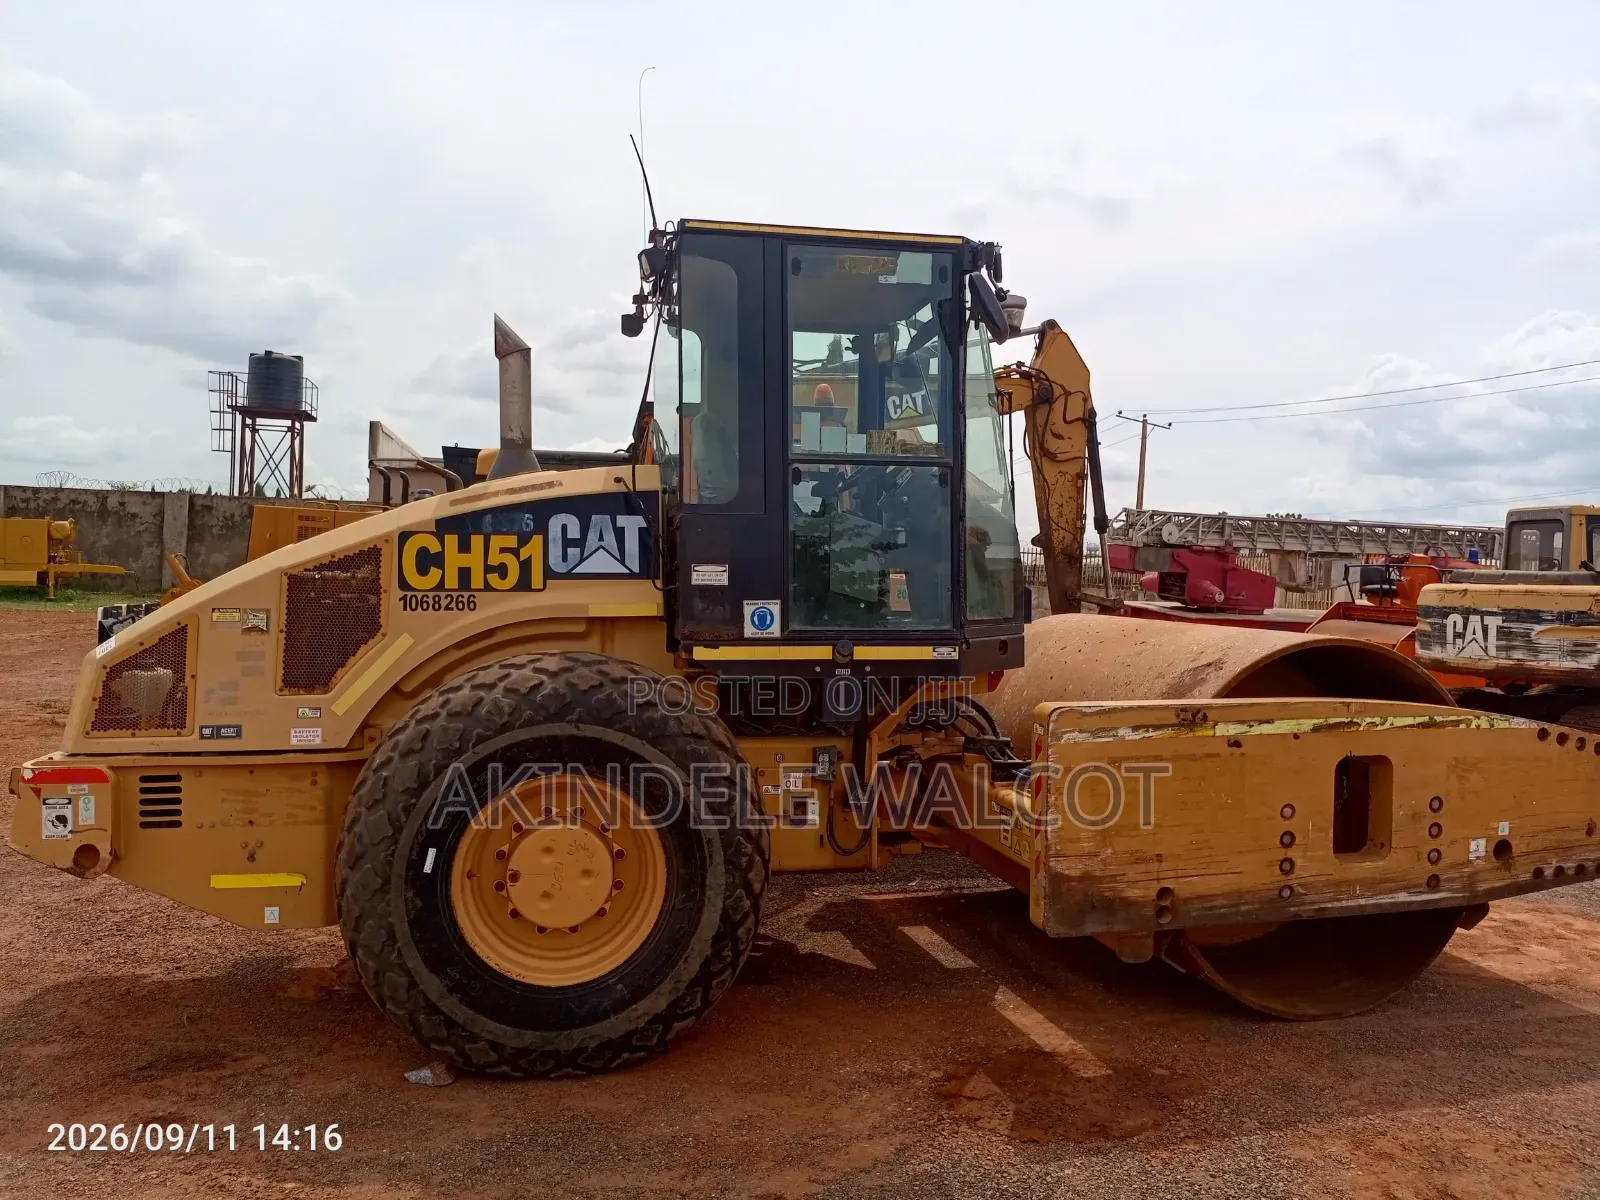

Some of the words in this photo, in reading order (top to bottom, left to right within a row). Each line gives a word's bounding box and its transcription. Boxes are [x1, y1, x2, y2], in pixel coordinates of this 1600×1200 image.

[886, 390, 926, 420] CAT
[402, 533, 544, 590] CH51
[548, 513, 648, 574] CAT
[398, 593, 477, 612] 1068266
[1445, 613, 1503, 657] CAT
[785, 780, 799, 788] OIL
